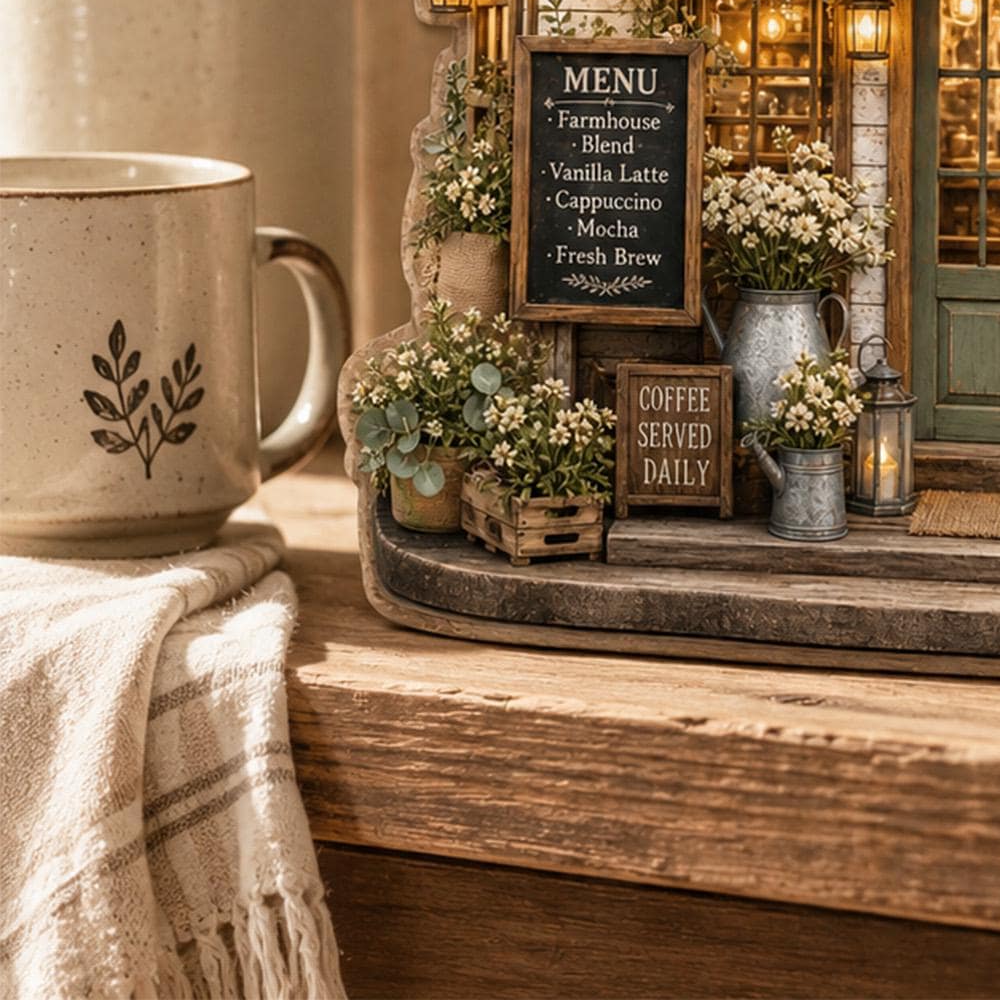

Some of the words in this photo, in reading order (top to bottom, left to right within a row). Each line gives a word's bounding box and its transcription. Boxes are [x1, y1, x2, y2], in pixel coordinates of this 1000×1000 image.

[563, 66, 658, 94] MENU
[557, 110, 661, 130] Farmhouse
[581, 135, 635, 155] Blend
[549, 162, 613, 183] Vanilla
[619, 165, 670, 184] Latte
[555, 190, 663, 214] Cappuccino
[577, 218, 640, 239] Mocha
[555, 245, 607, 266] Fresh
[614, 247, 663, 267] Brew
[638, 385, 711, 413] COFFEE
[637, 421, 713, 449] SERVED
[643, 457, 710, 487] DAILY
